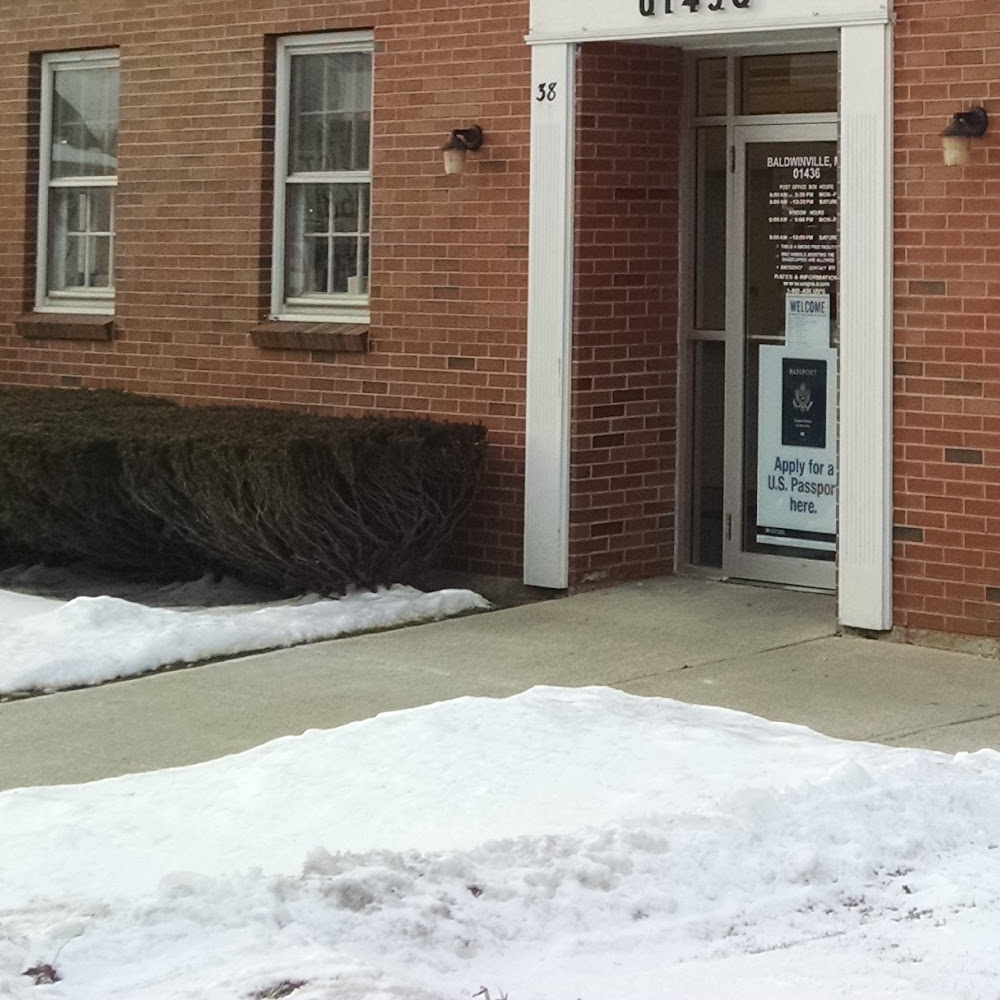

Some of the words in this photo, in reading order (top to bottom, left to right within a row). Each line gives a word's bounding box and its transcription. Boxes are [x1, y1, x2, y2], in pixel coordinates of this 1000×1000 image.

[536, 82, 557, 102] 38
[793, 168, 821, 179] 01436
[790, 300, 826, 313] WELCOME
[774, 456, 805, 476] Apply
[809, 459, 824, 475] for
[827, 464, 834, 476] a
[767, 475, 788, 492] U.S.
[789, 497, 817, 514] here.
